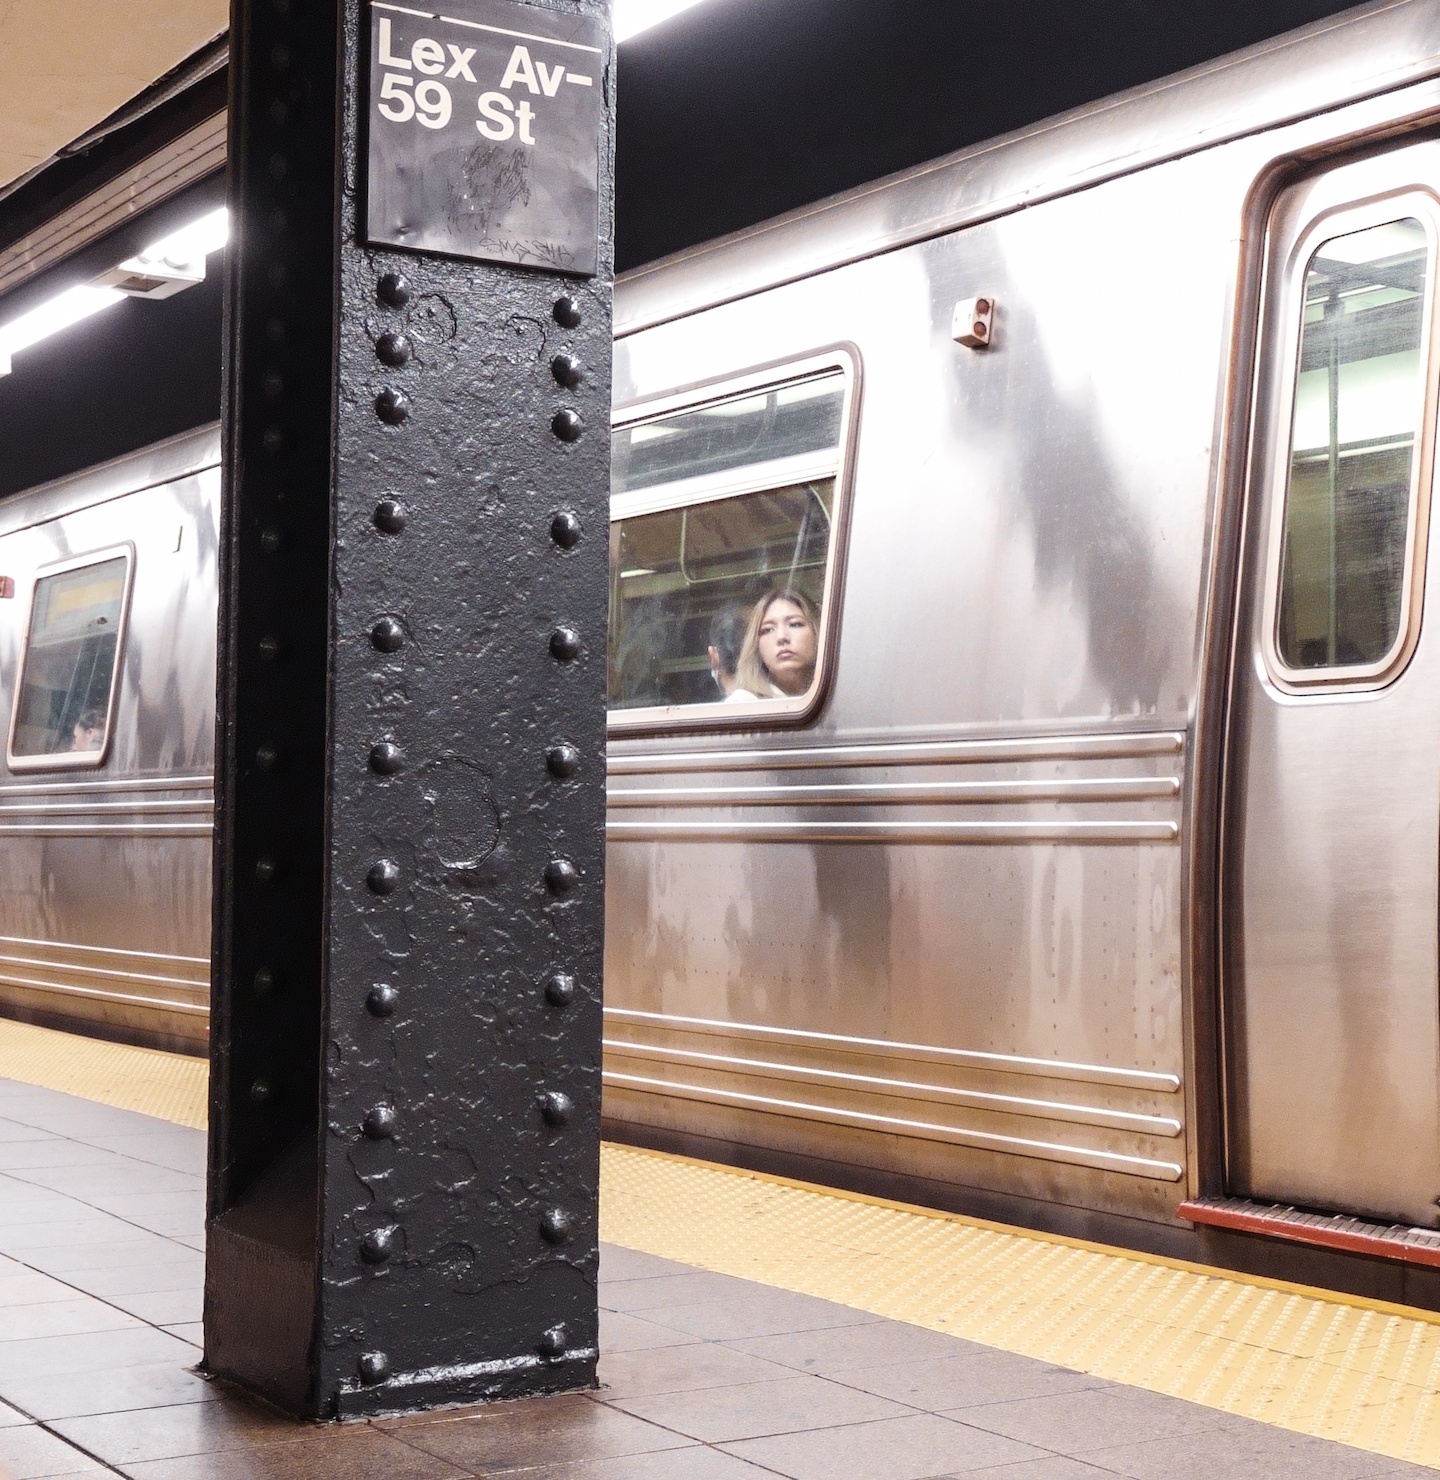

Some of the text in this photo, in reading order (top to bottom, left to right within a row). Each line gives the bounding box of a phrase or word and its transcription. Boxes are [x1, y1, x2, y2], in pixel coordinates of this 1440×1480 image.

[378, 17, 478, 83] Lex
[377, 72, 536, 146] 59 St
